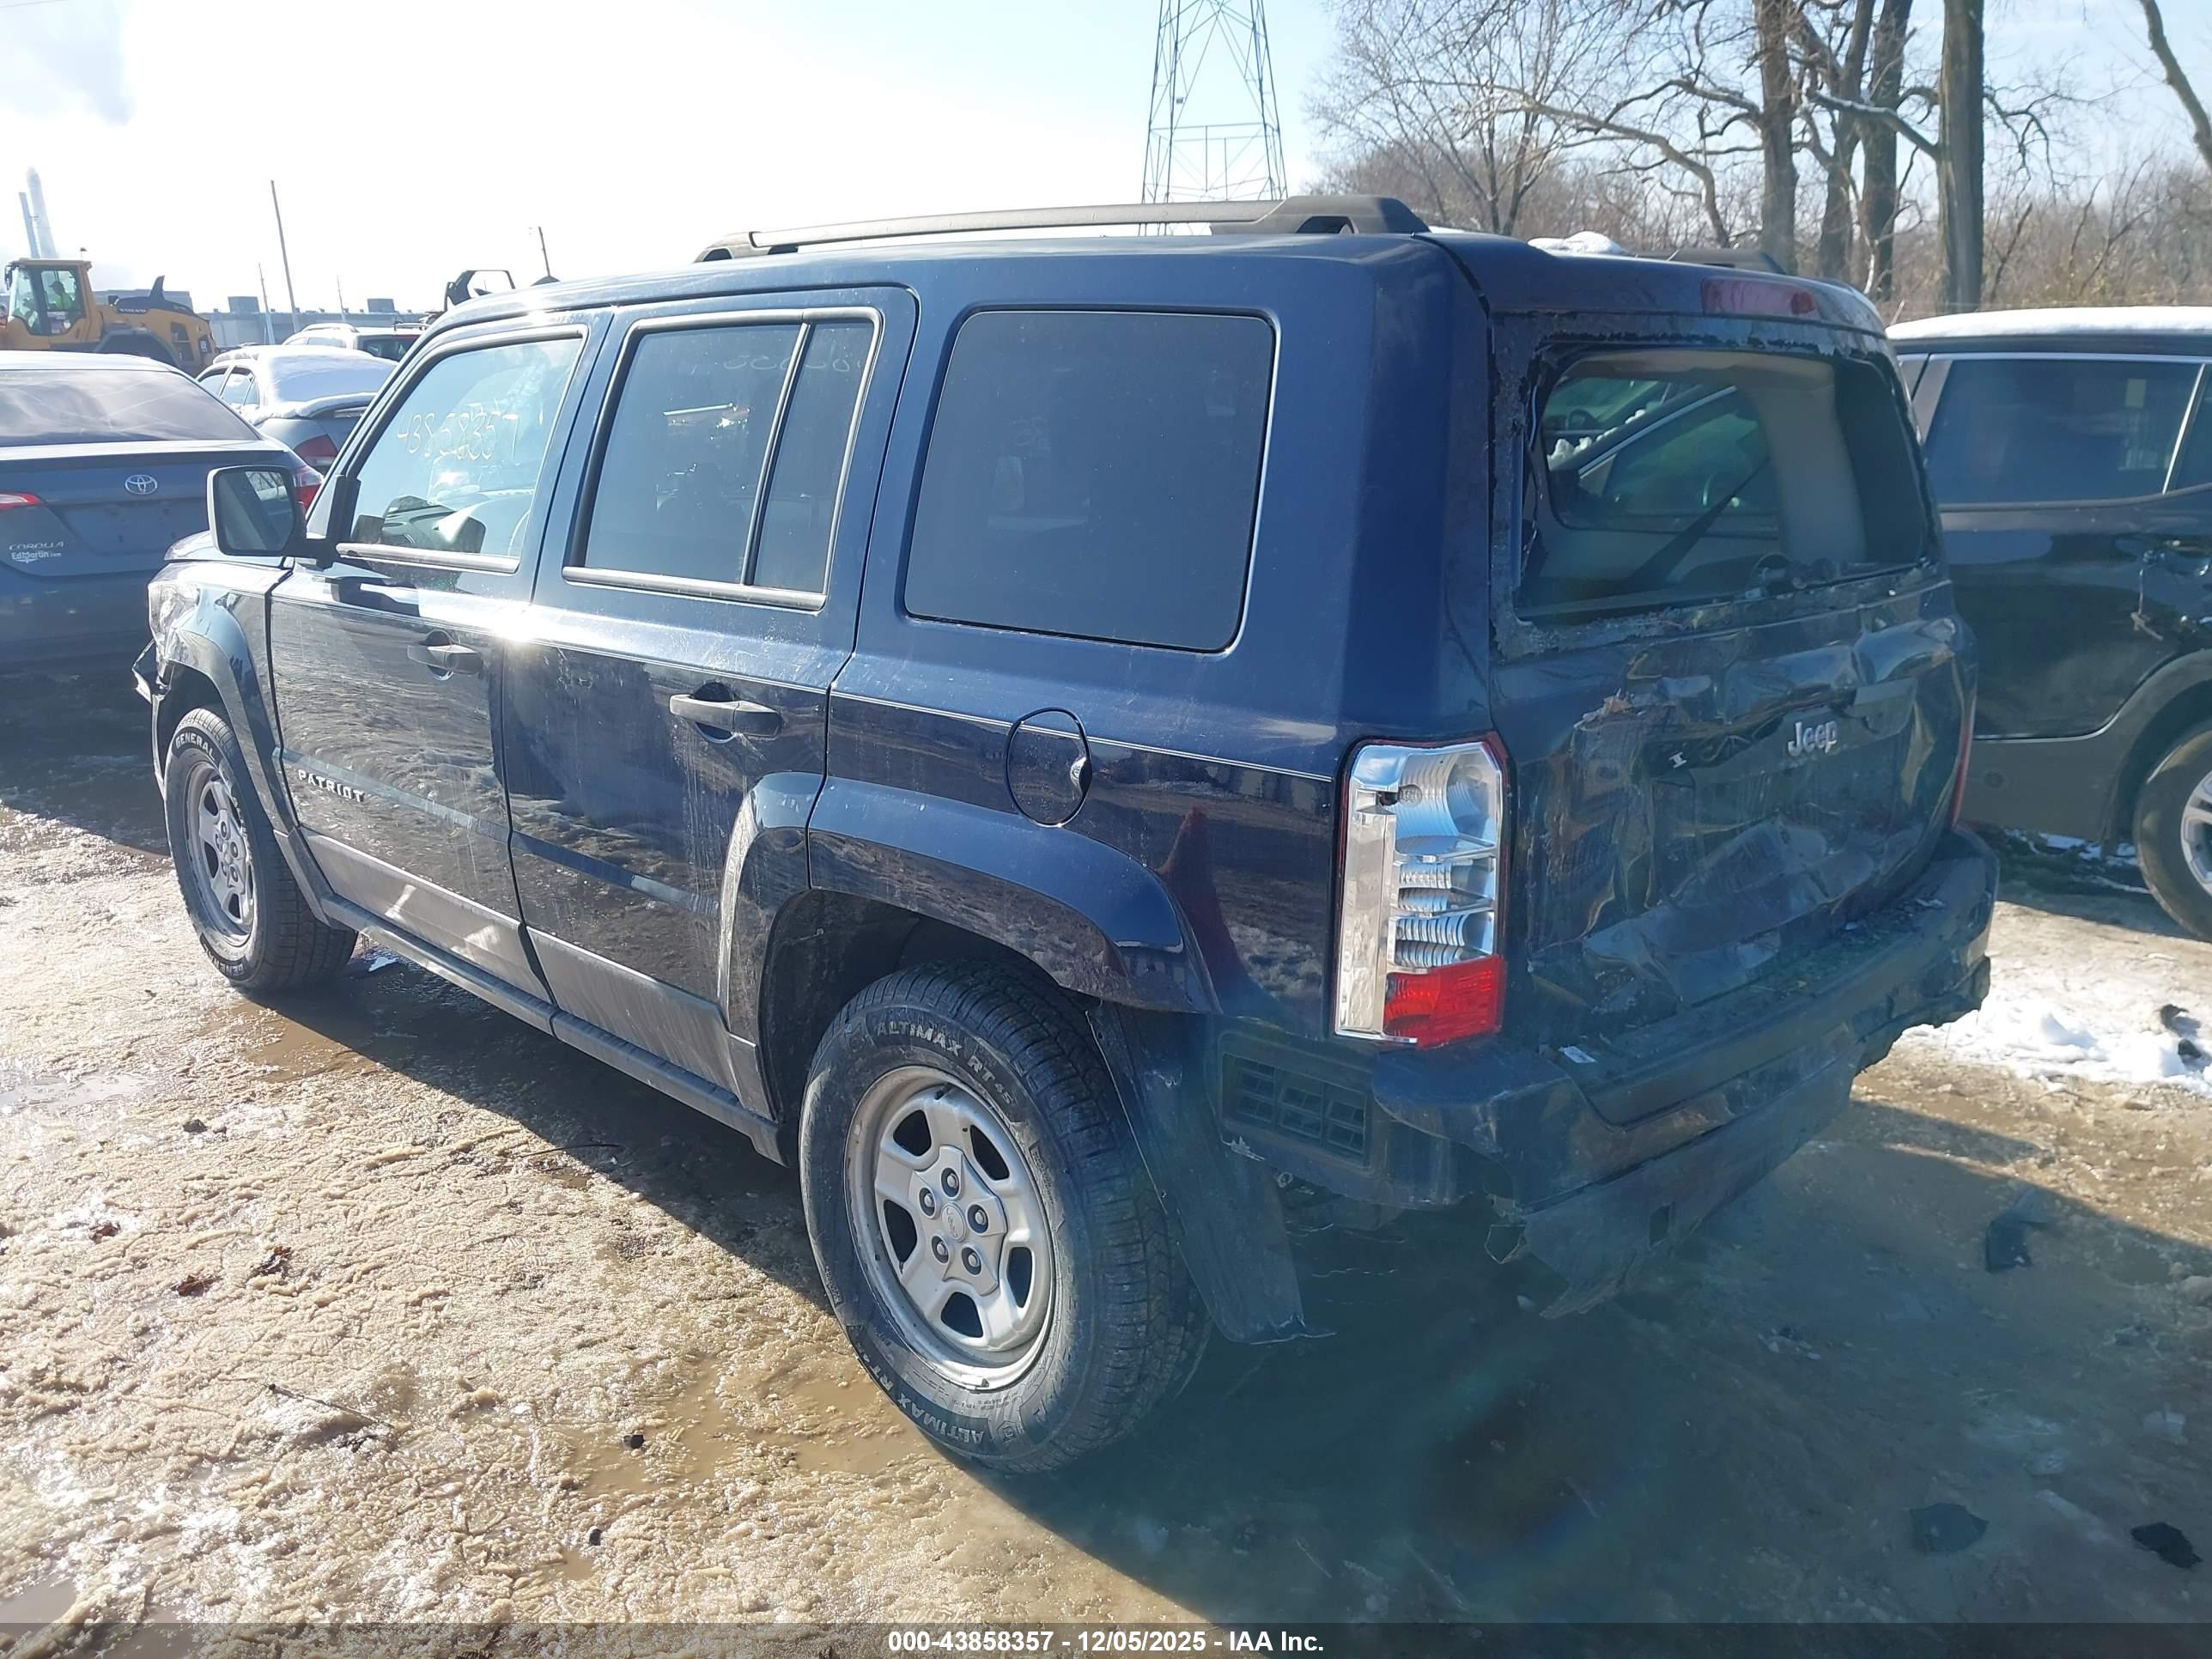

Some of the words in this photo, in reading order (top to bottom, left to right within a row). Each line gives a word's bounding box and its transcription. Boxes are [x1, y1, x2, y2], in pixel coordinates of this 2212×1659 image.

[9, 541, 64, 550] COROLLA
[175, 732, 216, 762] GENERAL
[1787, 720, 1838, 757] Jeep
[297, 769, 365, 803] PATRIOT
[876, 1020, 963, 1056] ALTIMAX
[895, 1392, 985, 1444] ALTIMAX
